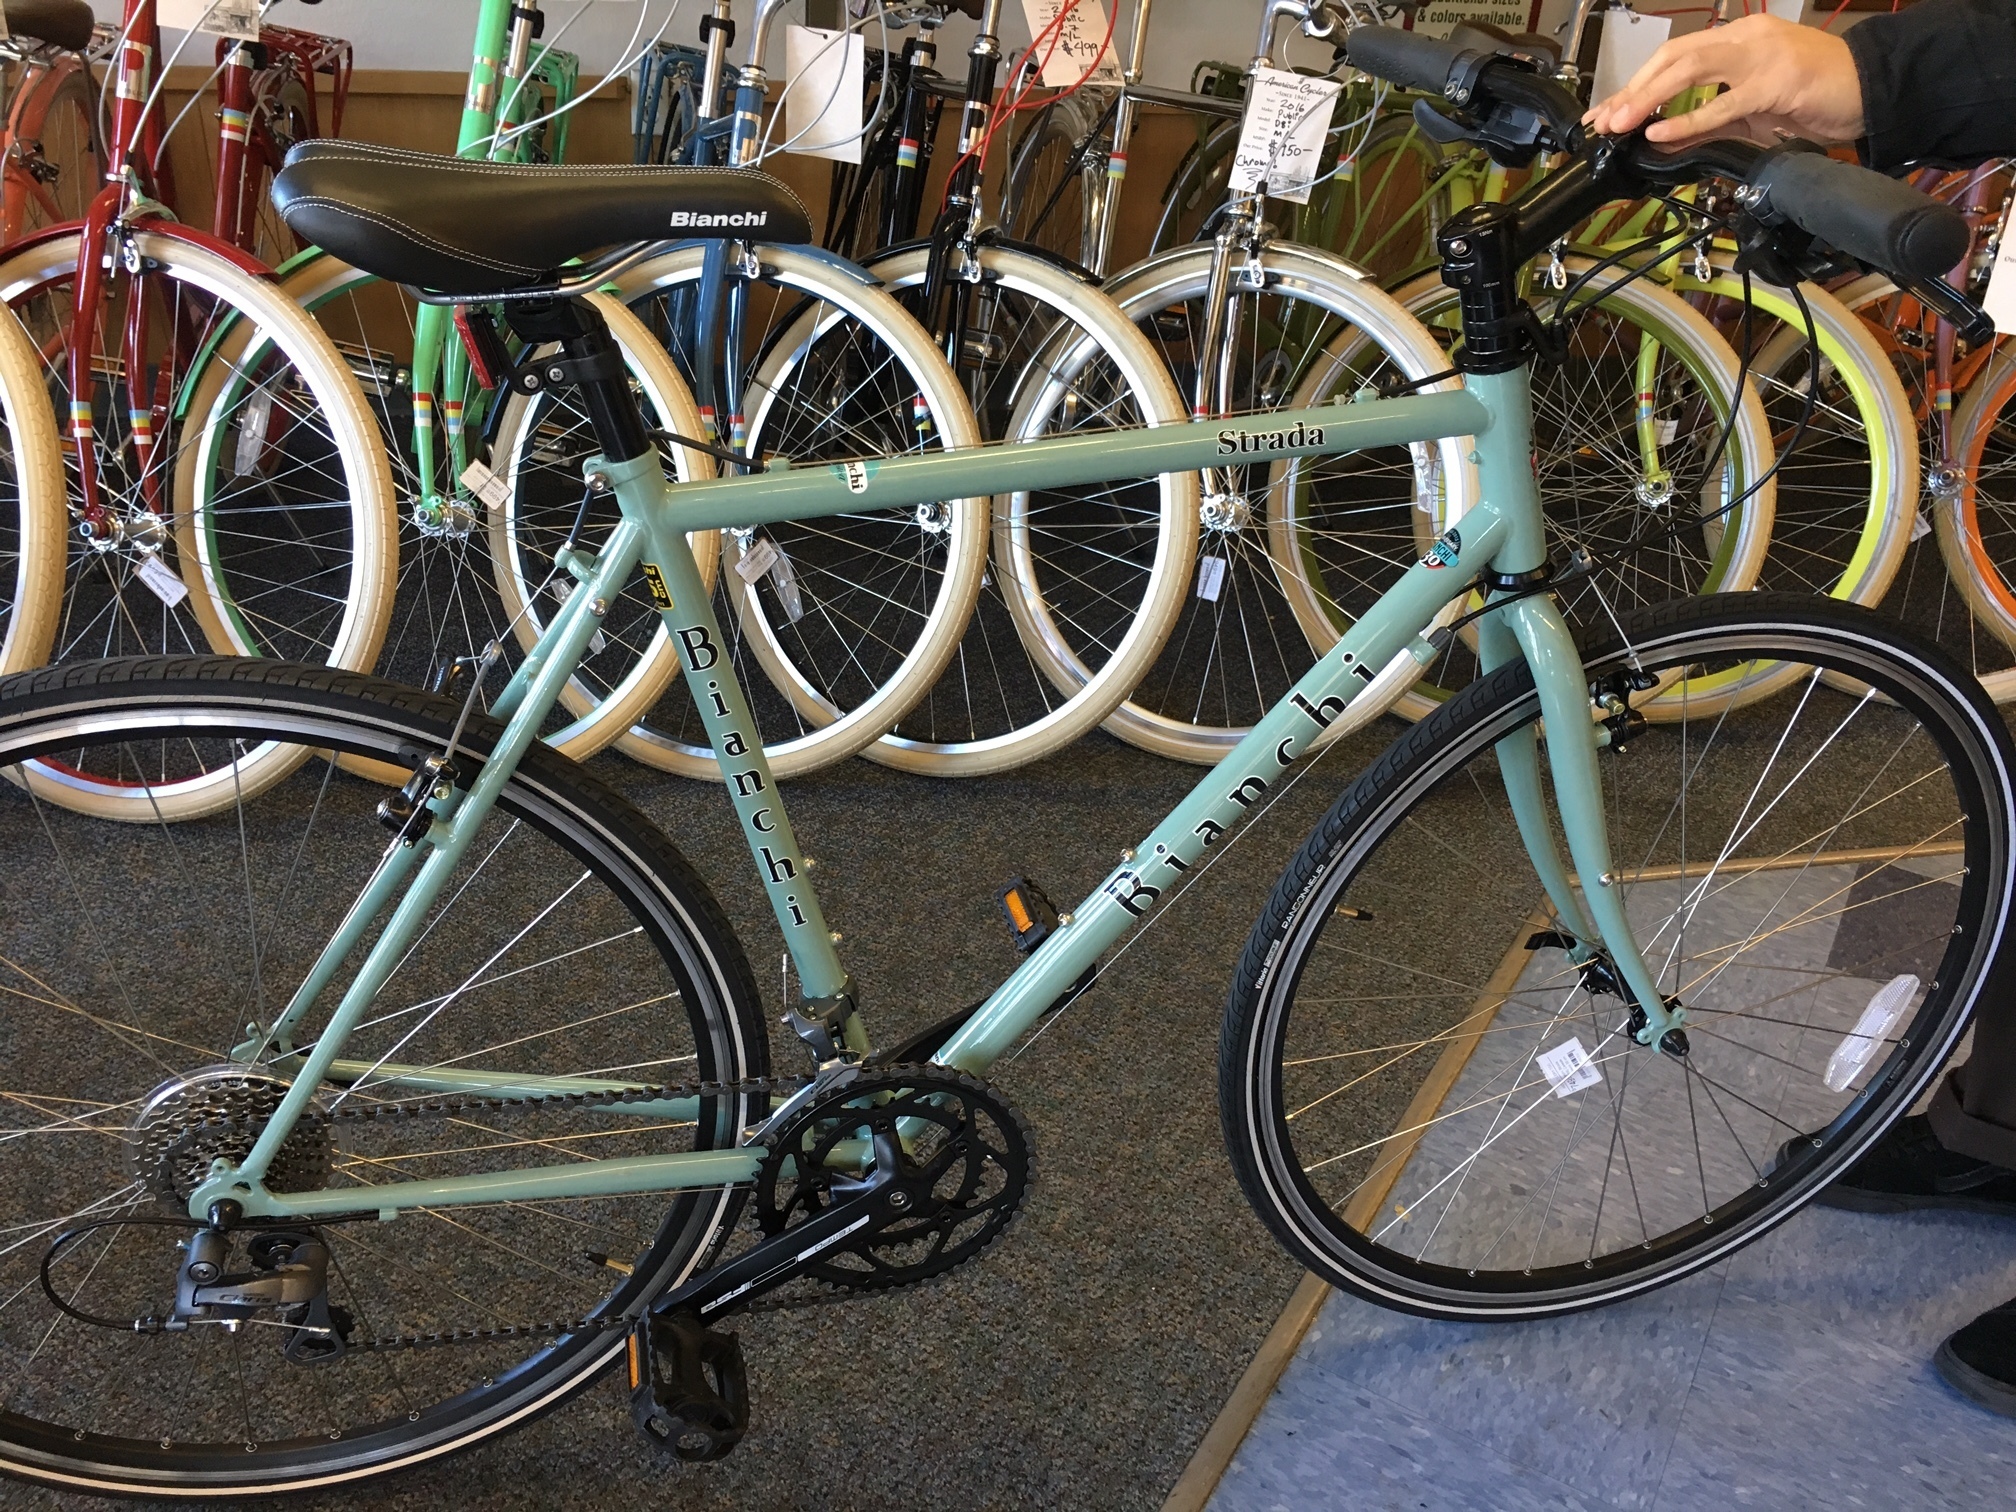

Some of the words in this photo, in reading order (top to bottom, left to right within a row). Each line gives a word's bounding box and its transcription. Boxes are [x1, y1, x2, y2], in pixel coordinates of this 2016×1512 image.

[1430, 10, 1466, 23] colors
[1265, 77, 1299, 91] American
[1280, 99, 1305, 112] 2016
[670, 211, 767, 227] Bianchi
[1216, 420, 1326, 456] Strada
[676, 625, 808, 928] Bianchi
[1103, 653, 1377, 918] Bianchi
